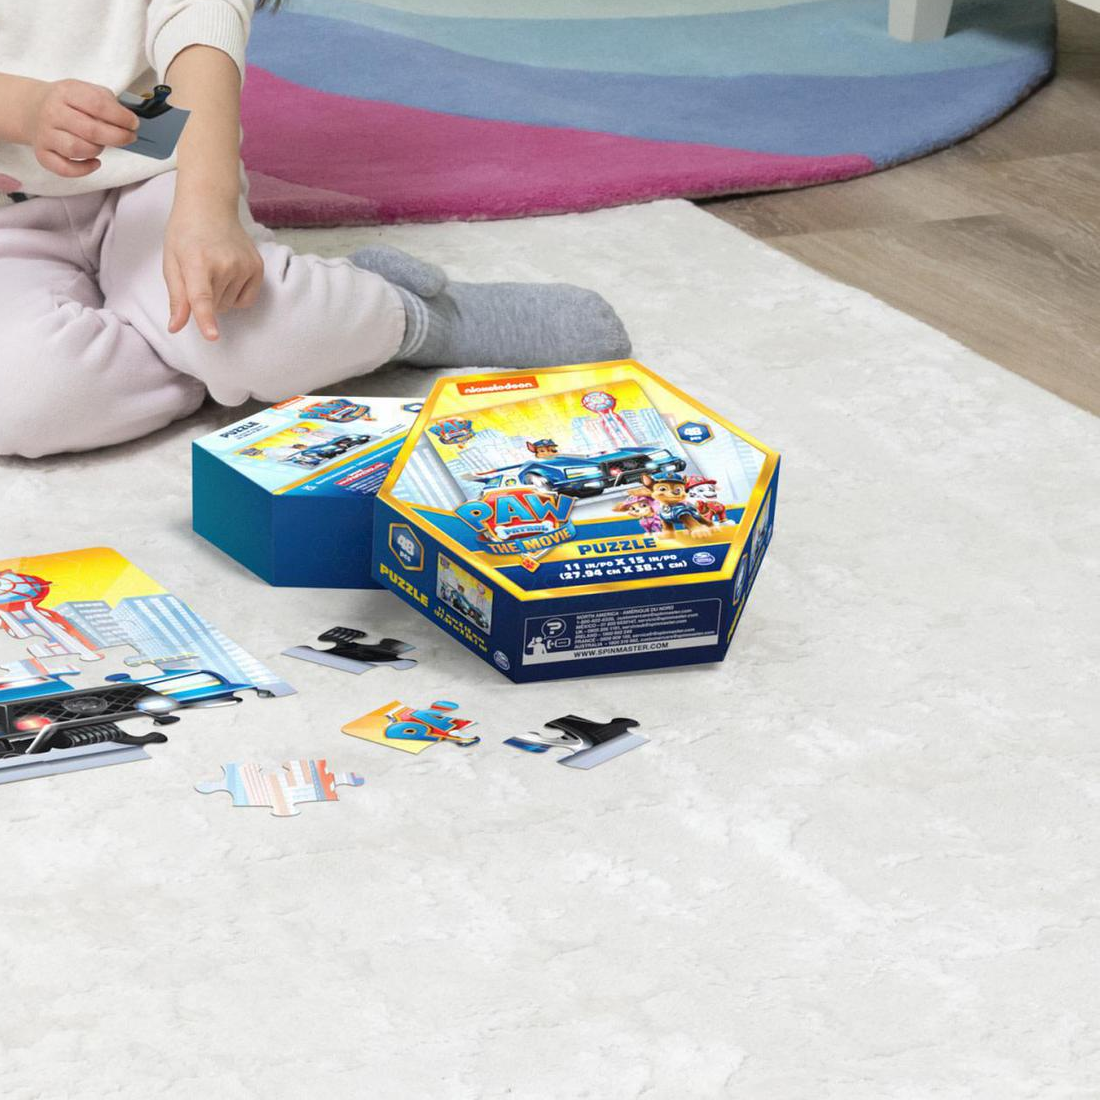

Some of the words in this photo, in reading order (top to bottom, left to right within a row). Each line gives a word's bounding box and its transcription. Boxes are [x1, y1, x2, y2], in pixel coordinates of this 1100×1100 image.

[464, 382, 533, 394] nickelodeon
[454, 493, 577, 533] PAW
[487, 542, 518, 554] THE
[522, 528, 571, 551] MOVIE
[578, 537, 657, 555] PUZZLE
[564, 562, 581, 571] 11
[614, 557, 627, 566] X
[628, 555, 645, 565] 15
[606, 568, 621, 576] CM
[623, 565, 634, 574] X
[380, 563, 429, 607] PUZZLE
[573, 641, 669, 658] WWW.SPINMASTER.COM
